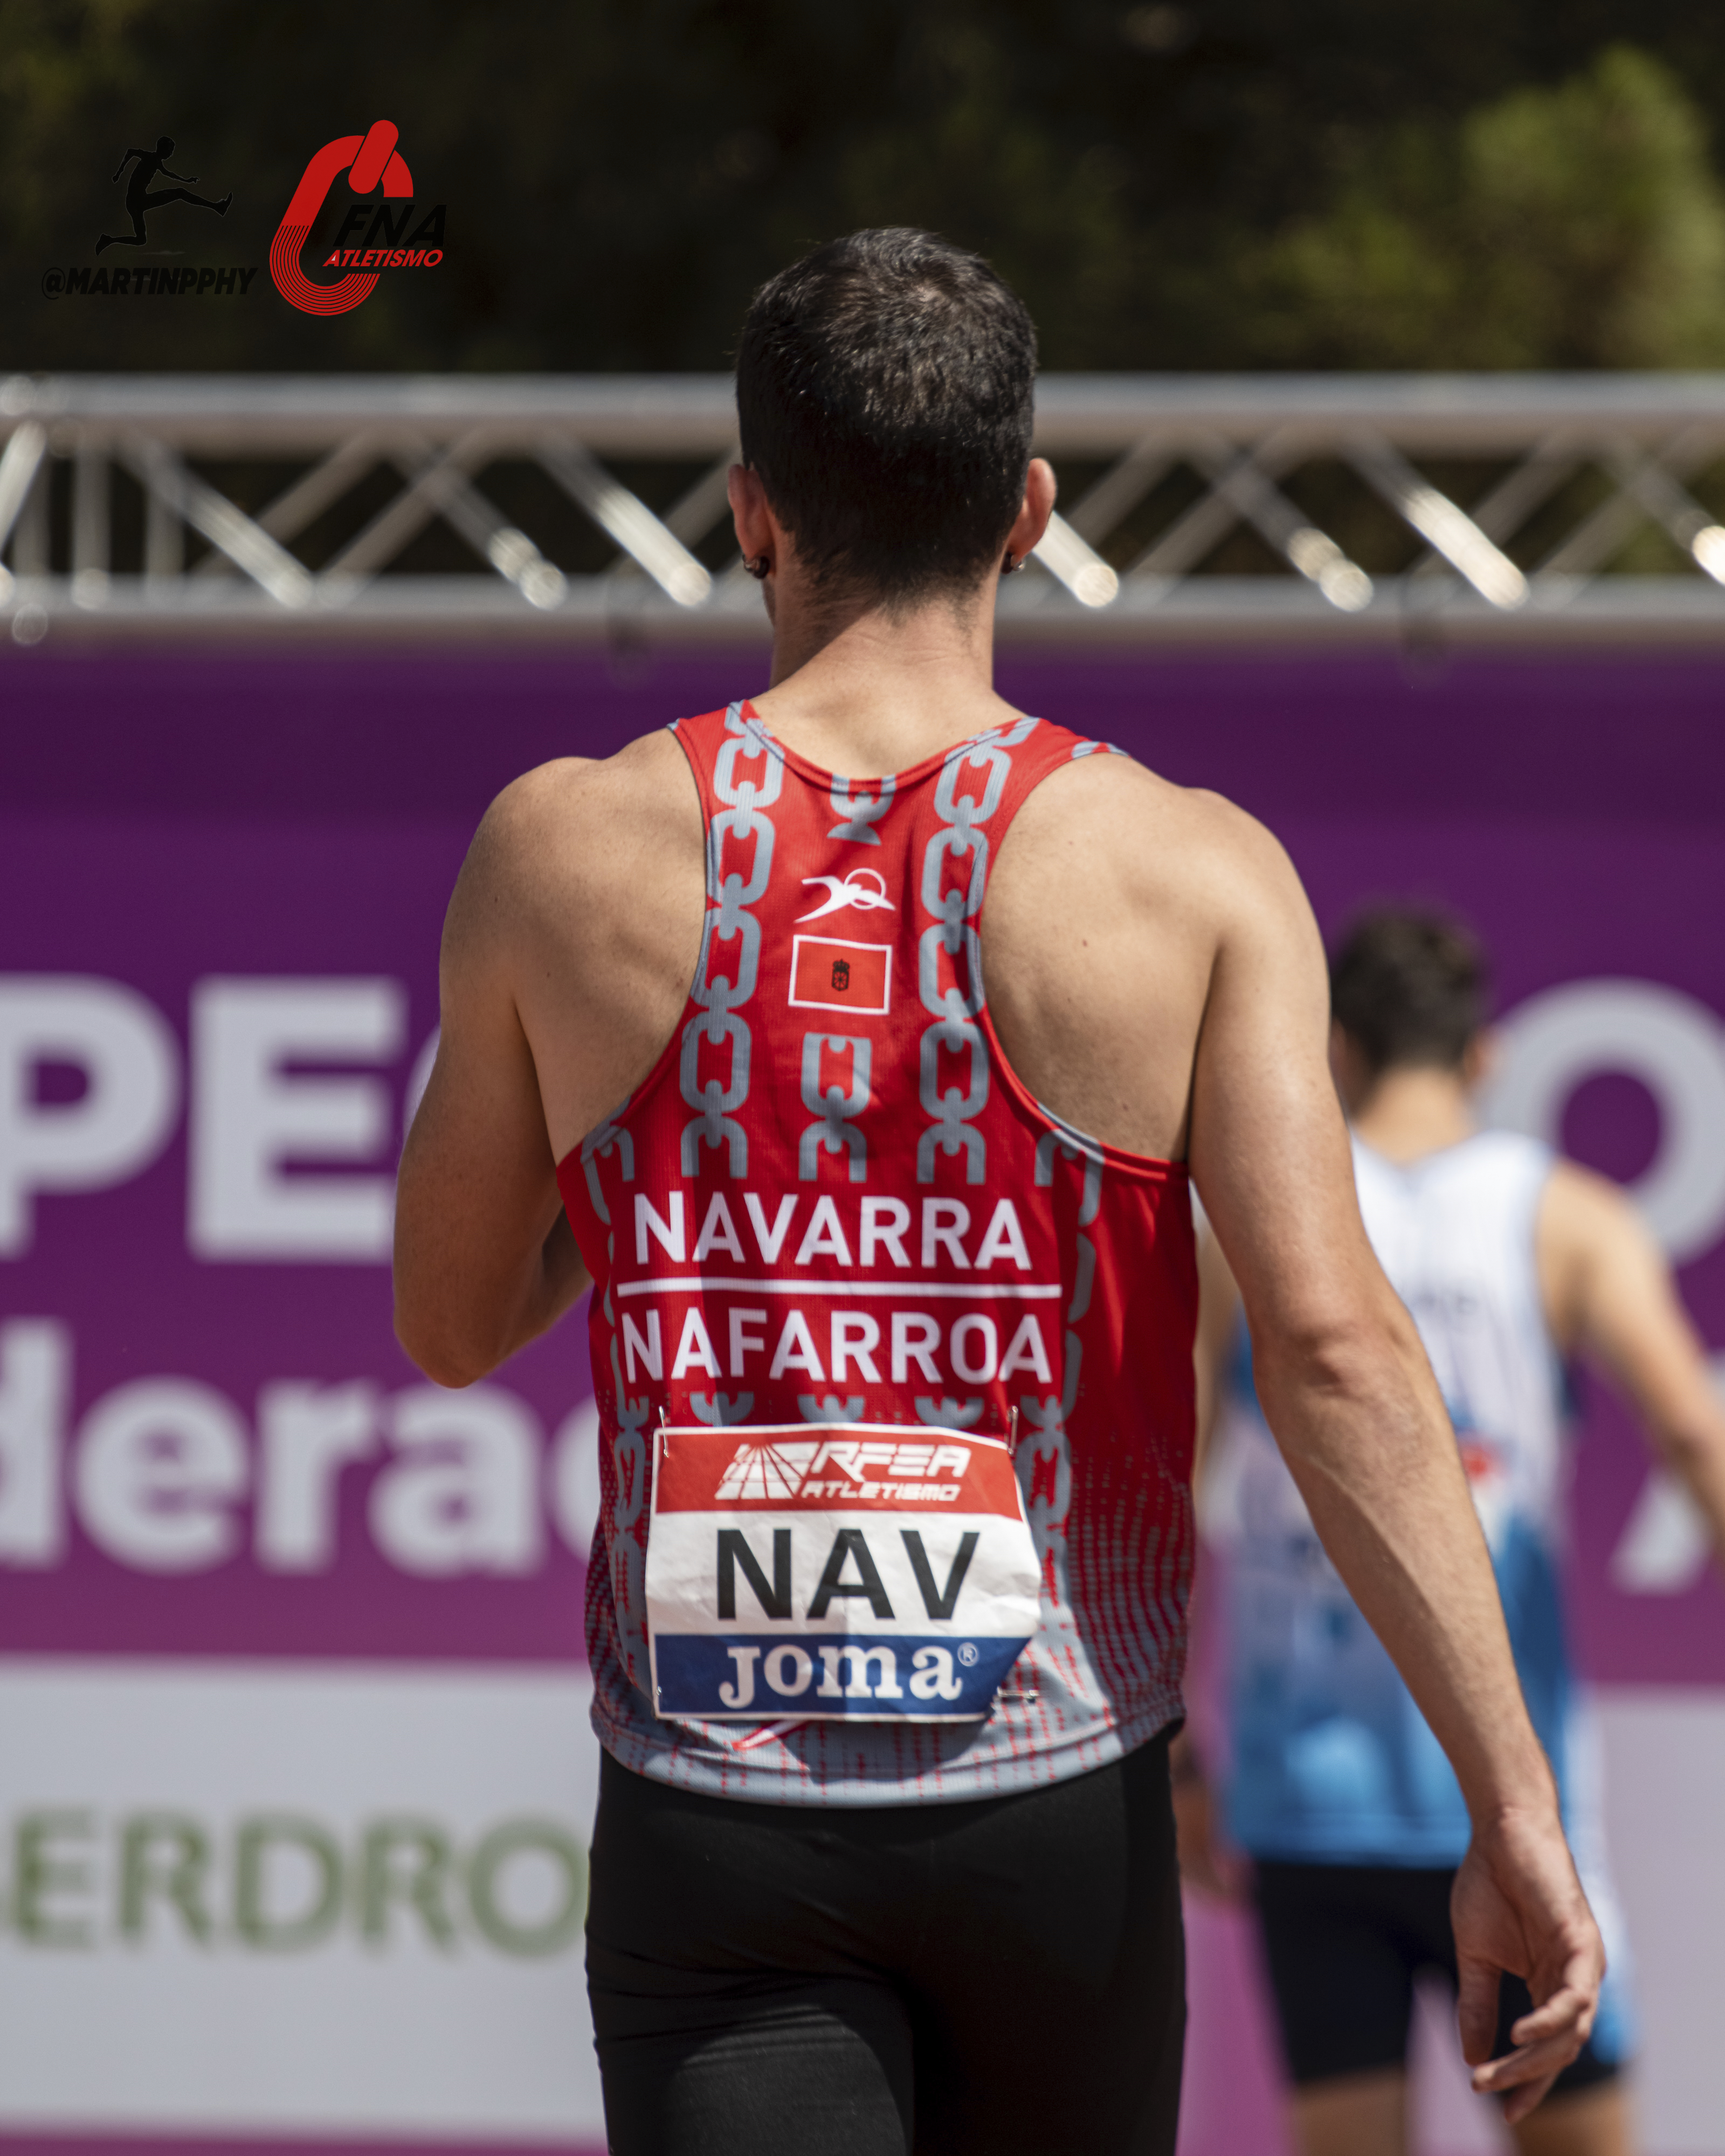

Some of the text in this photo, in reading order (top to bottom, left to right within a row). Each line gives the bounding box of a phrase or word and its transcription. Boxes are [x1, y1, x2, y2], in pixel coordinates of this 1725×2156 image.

[0, 975, 441, 1262] PE
[633, 1191, 1033, 1270] NAVARRA
[622, 1307, 1053, 1385] NAFARROA
[801, 1480, 961, 1502] ATLETISMO
[810, 1440, 972, 1482] RFEA
[716, 1528, 981, 1622] NAV
[0, 1803, 589, 1963] ERDRO
